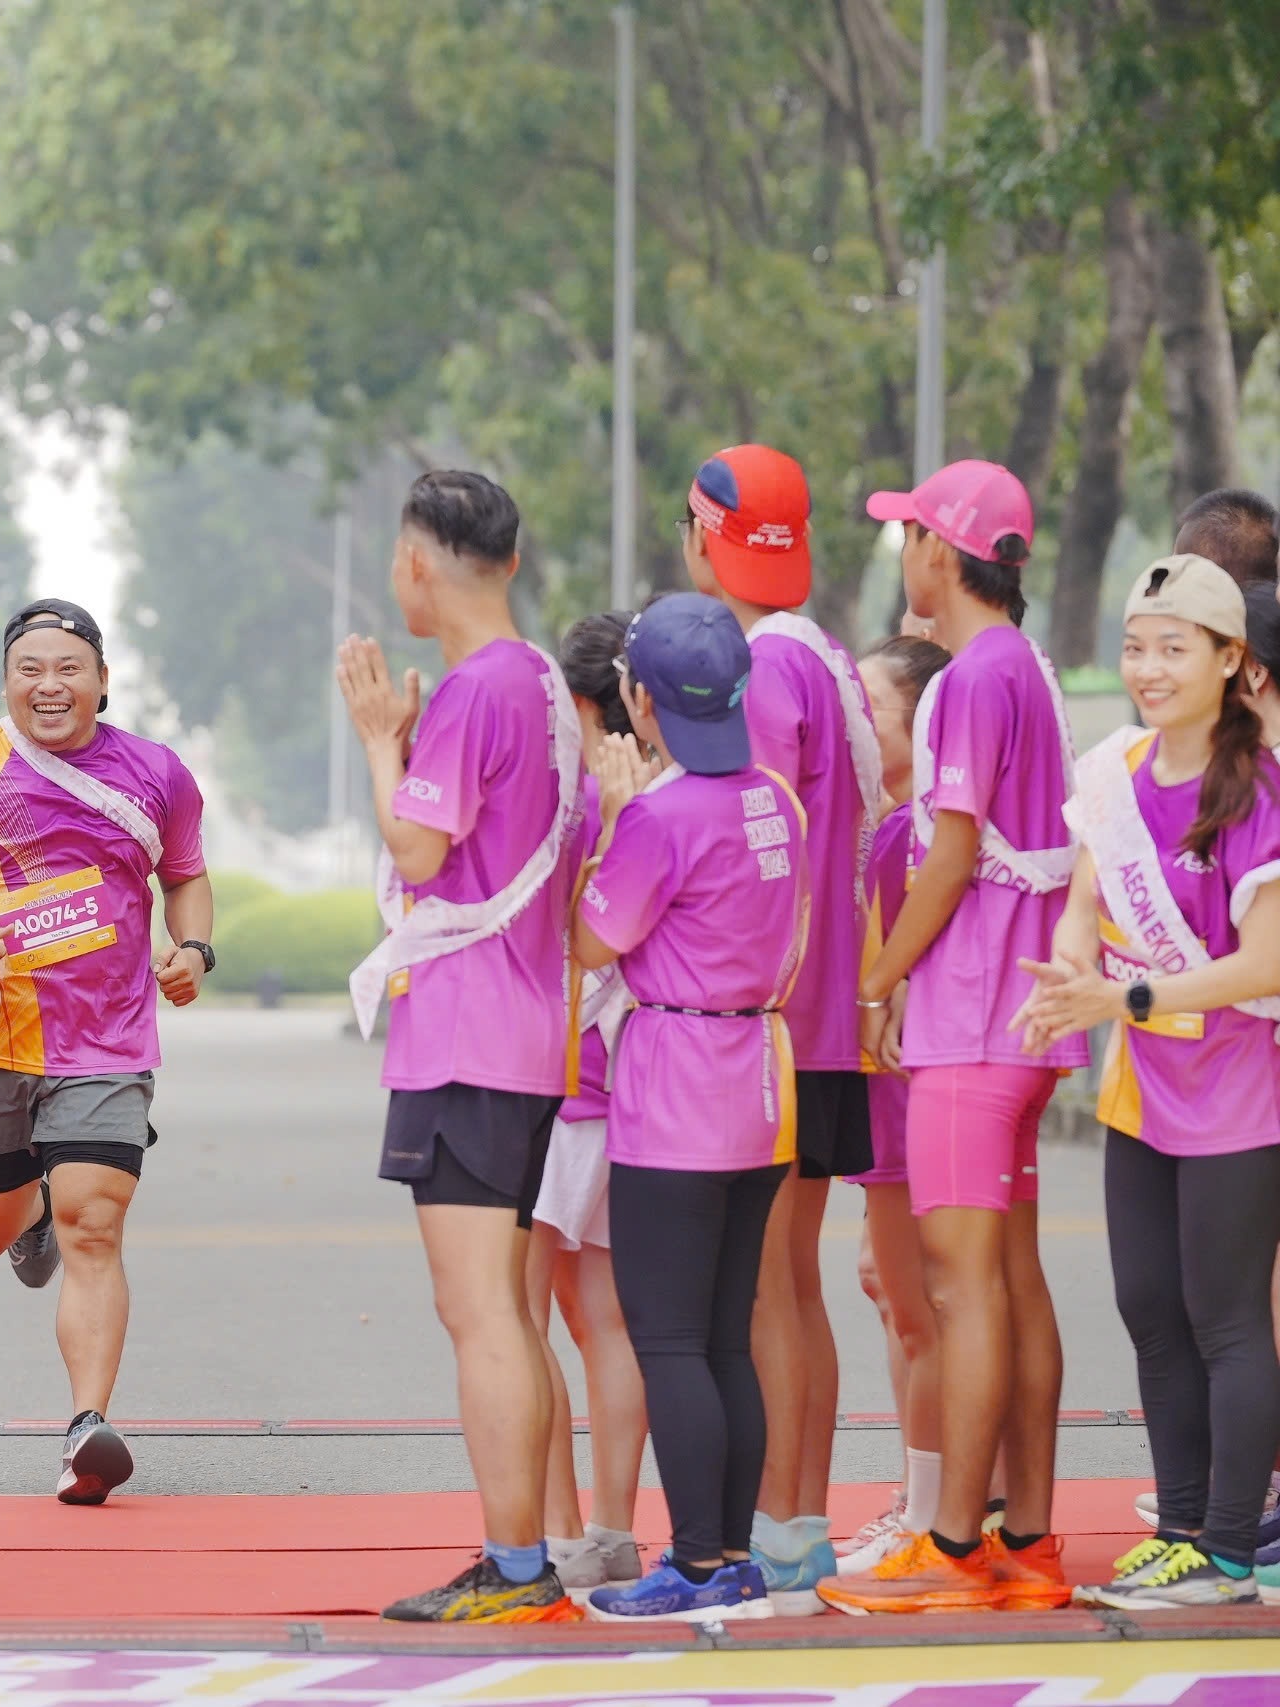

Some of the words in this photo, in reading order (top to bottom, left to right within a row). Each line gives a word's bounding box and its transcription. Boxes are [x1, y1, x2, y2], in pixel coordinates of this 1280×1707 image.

[14, 895, 99, 939] A0074-5
[1120, 860, 1157, 926] AEON
[1143, 920, 1186, 974] EKID
